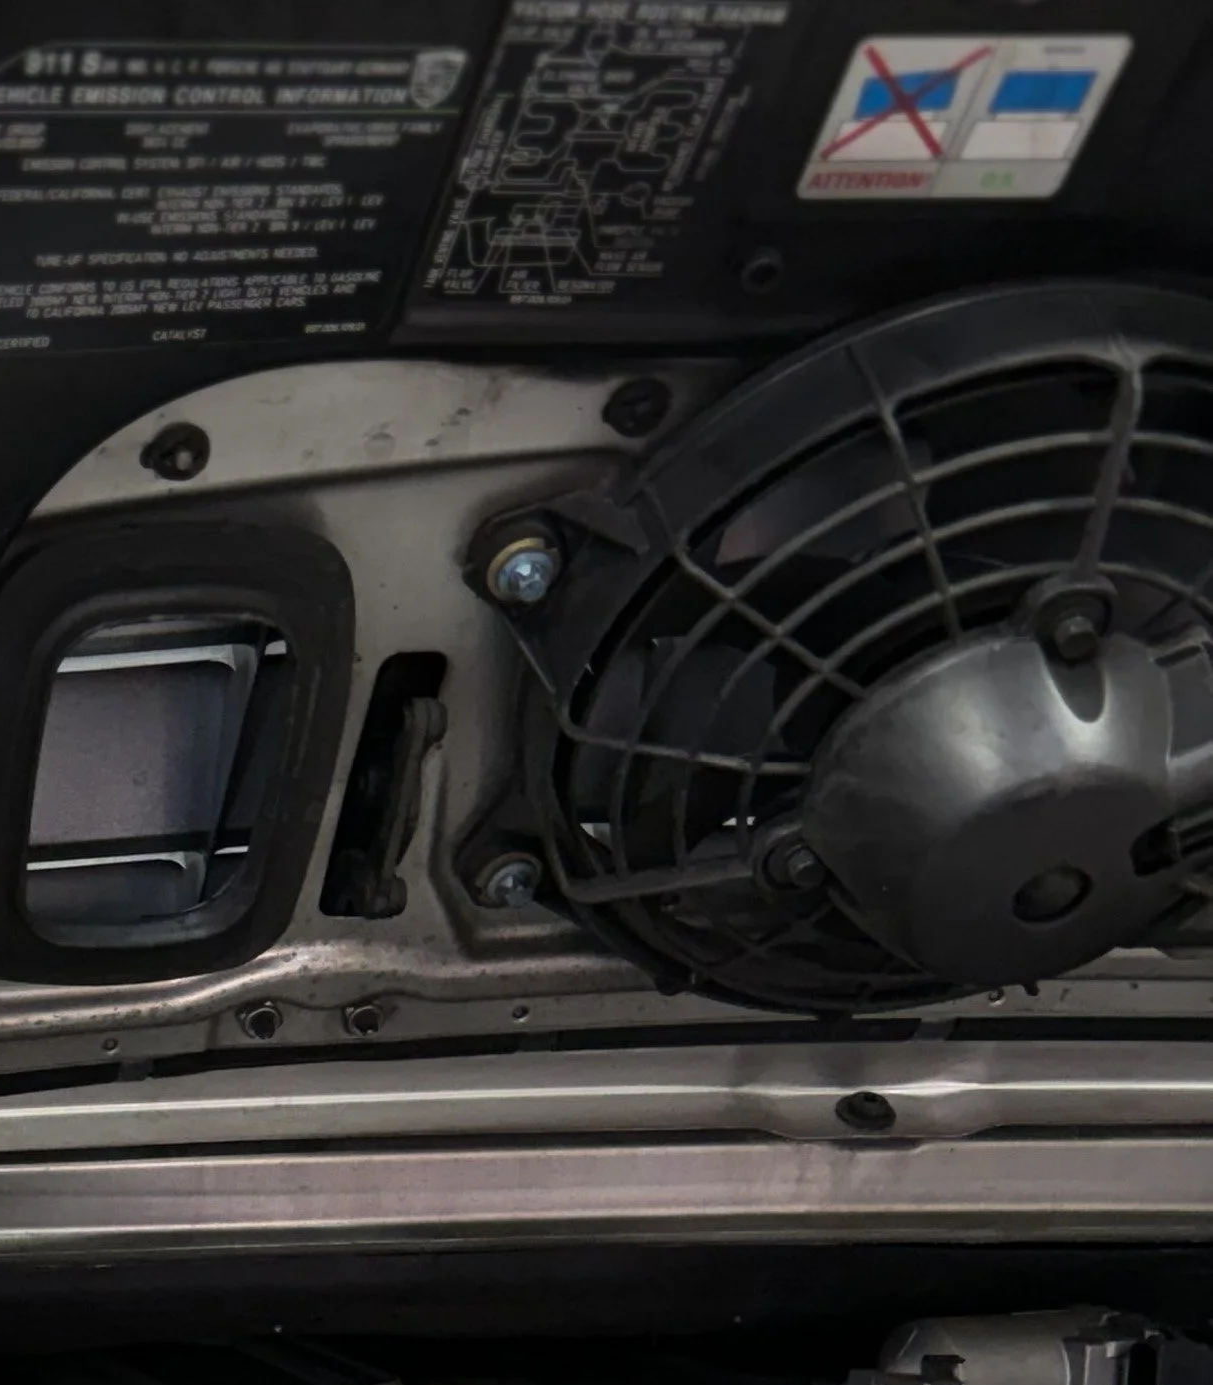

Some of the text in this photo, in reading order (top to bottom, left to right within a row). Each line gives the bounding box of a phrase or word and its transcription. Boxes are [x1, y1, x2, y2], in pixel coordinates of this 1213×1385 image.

[585, 3, 629, 19] HOSE
[712, 5, 787, 23] DIAGRAM
[24, 51, 74, 77] 911
[81, 50, 102, 77] S
[70, 84, 166, 105] EMISSION
[173, 84, 266, 105] CONTROL
[275, 85, 410, 105] INFORMATION
[22, 157, 76, 171] EMISSION
[37, 280, 98, 295] CONFORMS
[102, 279, 117, 293] TO
[166, 276, 240, 291] REGULATIONS
[243, 272, 309, 287] APPLICABLE
[311, 271, 327, 285] TO
[329, 269, 383, 284] GASOLINE
[211, 286, 243, 301] LIGHT
[245, 285, 276, 300] DUTY
[278, 283, 330, 298] VEHICLES
[332, 282, 357, 296] AND
[43, 303, 106, 319] CALIFORNIA
[182, 299, 204, 313] LEV
[206, 297, 273, 312] PASSENGER
[152, 328, 208, 342] CATALYST
